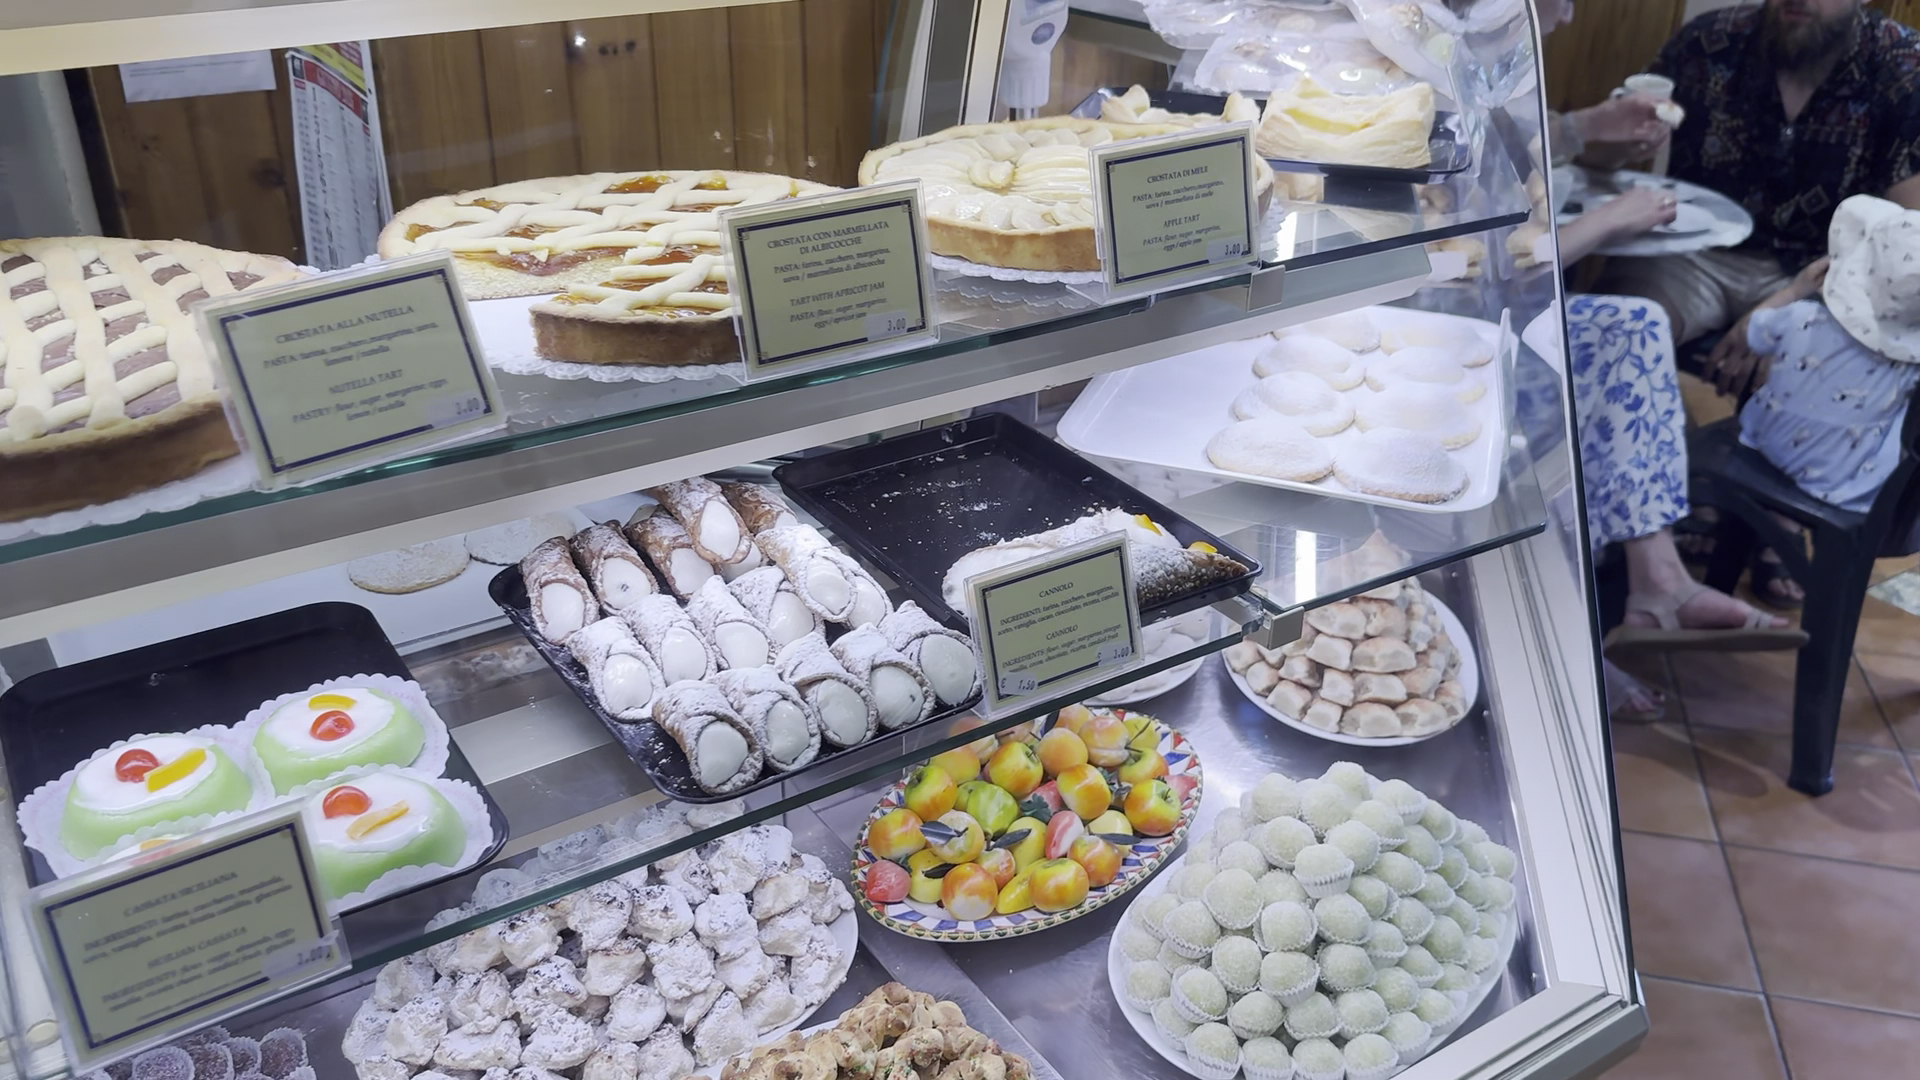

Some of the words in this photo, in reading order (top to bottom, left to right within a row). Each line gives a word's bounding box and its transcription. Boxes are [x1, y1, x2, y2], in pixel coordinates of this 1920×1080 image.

[1146, 171, 1181, 183] CROSTATA
[1183, 214, 1200, 222] TART
[767, 234, 811, 248] CROSTATA
[812, 231, 831, 240] CON
[832, 221, 889, 237] MARMELLATA
[799, 246, 809, 254] DI
[810, 237, 862, 252] ALBICOCCHE
[1224, 242, 1240, 255] 3.00
[790, 296, 810, 306] TART
[886, 316, 906, 332] 3.00
[1038, 582, 1073, 597] CANNOLO
[1045, 624, 1078, 640] CANNOLO
[1113, 646, 1130, 659] 3.00
[1001, 678, 1007, 688] €
[1018, 680, 1036, 690] 1.50
